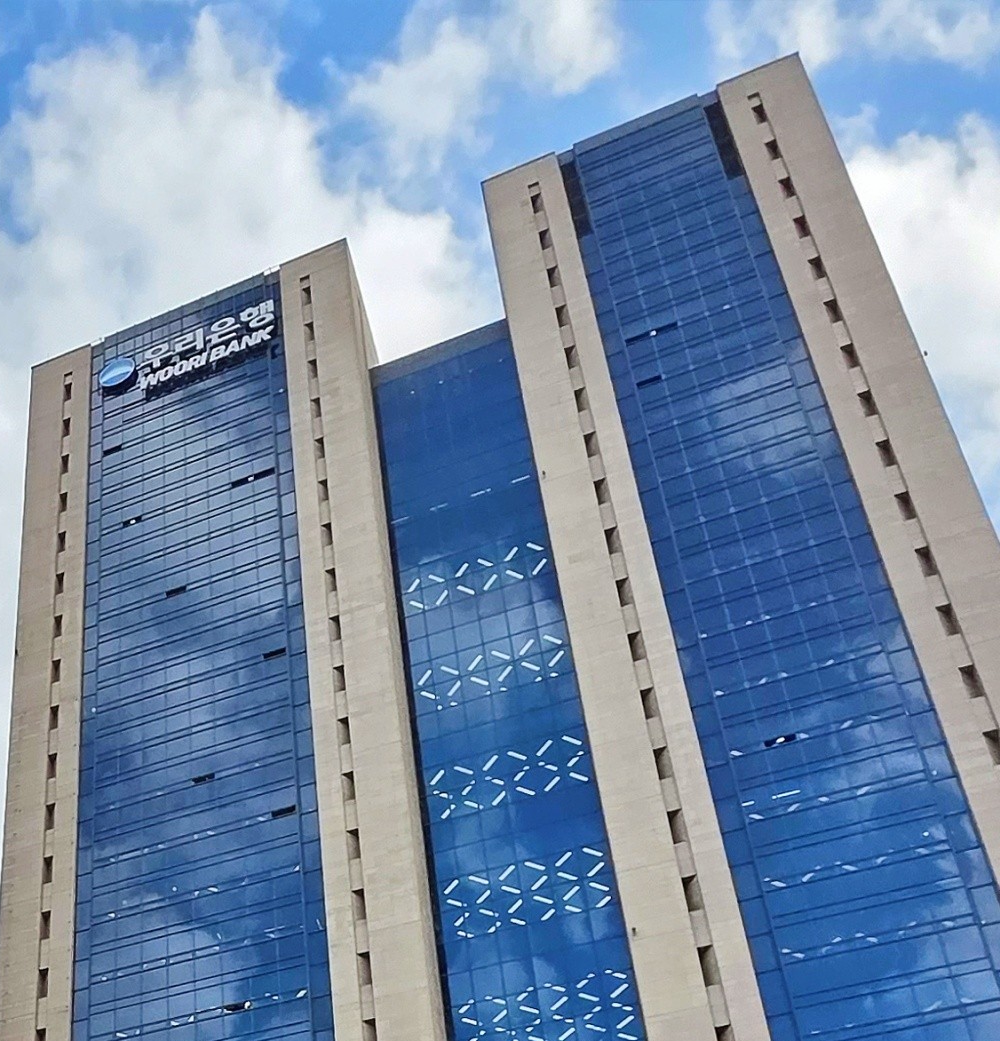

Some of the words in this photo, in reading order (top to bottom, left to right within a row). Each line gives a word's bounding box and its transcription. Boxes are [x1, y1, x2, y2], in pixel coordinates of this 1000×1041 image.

[136, 299, 275, 369] 우리은행
[140, 351, 208, 390] WOORI
[208, 325, 275, 362] BANK
